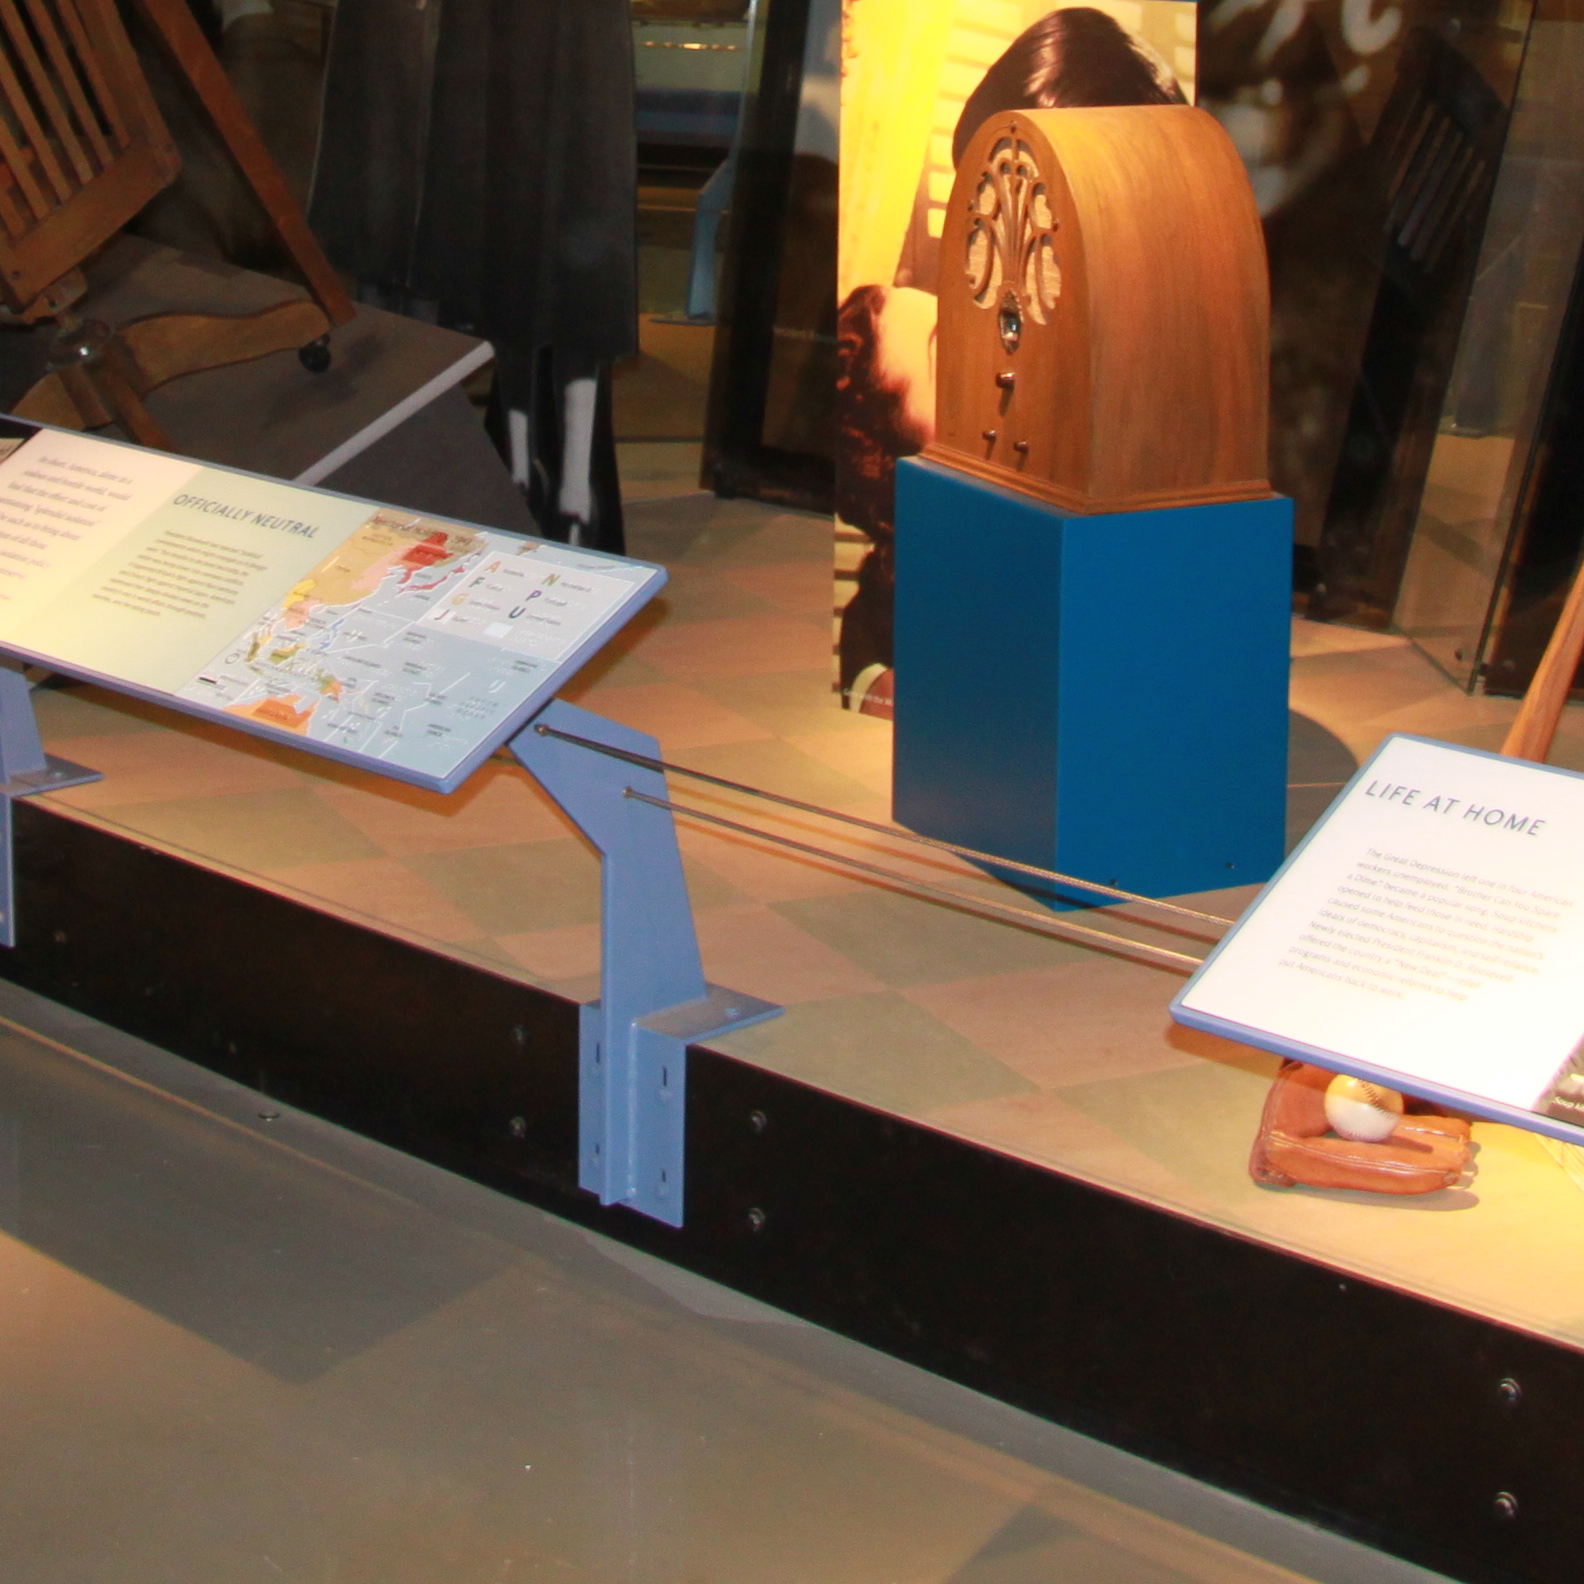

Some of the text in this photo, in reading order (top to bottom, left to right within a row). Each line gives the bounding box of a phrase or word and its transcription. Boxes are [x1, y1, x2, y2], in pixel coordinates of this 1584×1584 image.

[173, 494, 320, 539] OFFICIALLY NEUTRAL
[1365, 780, 1546, 836] LIFE AT HOME
